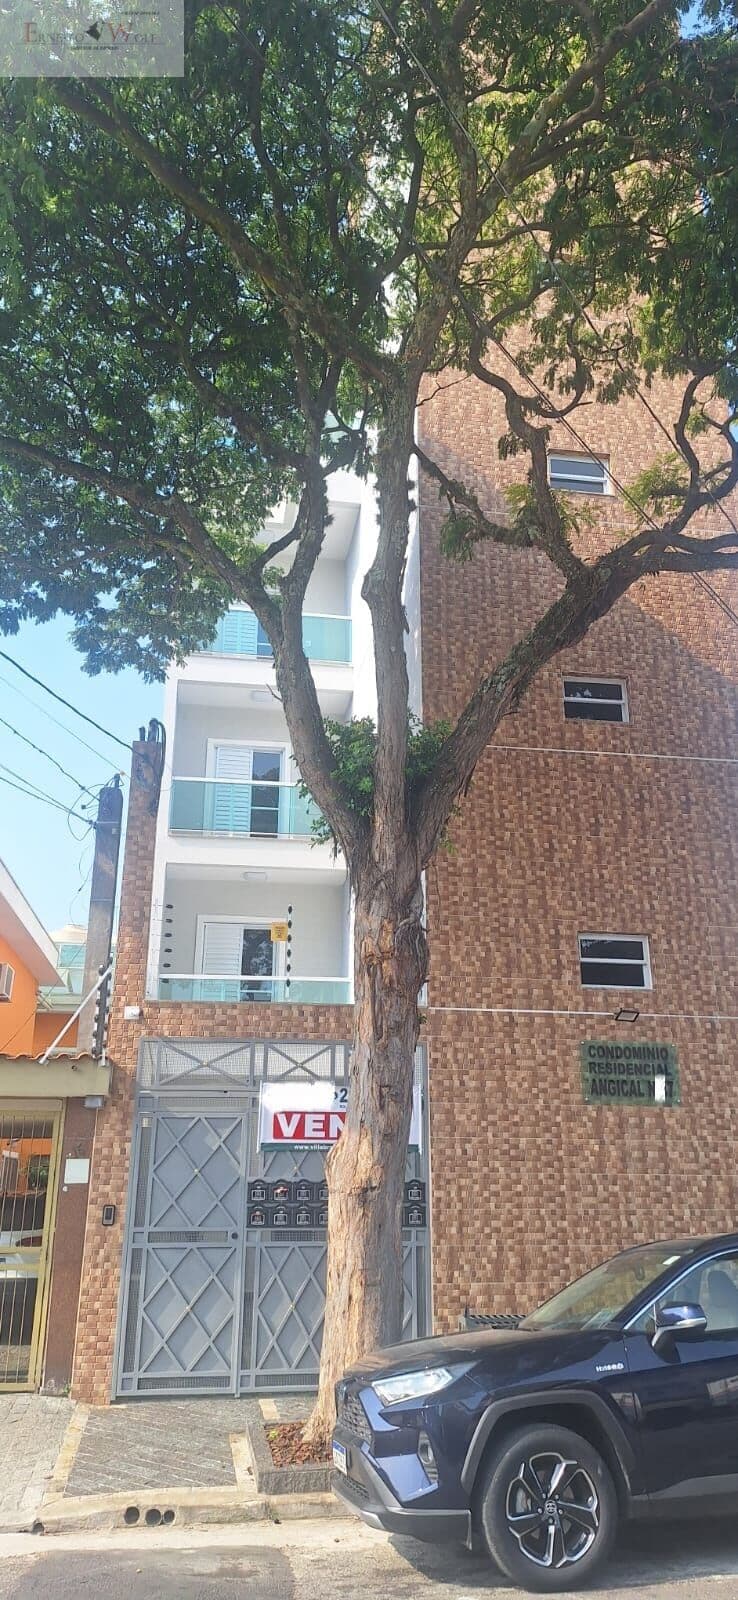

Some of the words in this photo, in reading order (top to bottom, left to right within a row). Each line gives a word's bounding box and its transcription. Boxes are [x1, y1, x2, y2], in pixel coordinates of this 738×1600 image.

[588, 1045, 669, 1060] CONDOMINIO
[588, 1062, 673, 1076] RESIDENCIAL
[591, 1079, 645, 1097] ANGICAL
[276, 1112, 346, 1138] VEN
